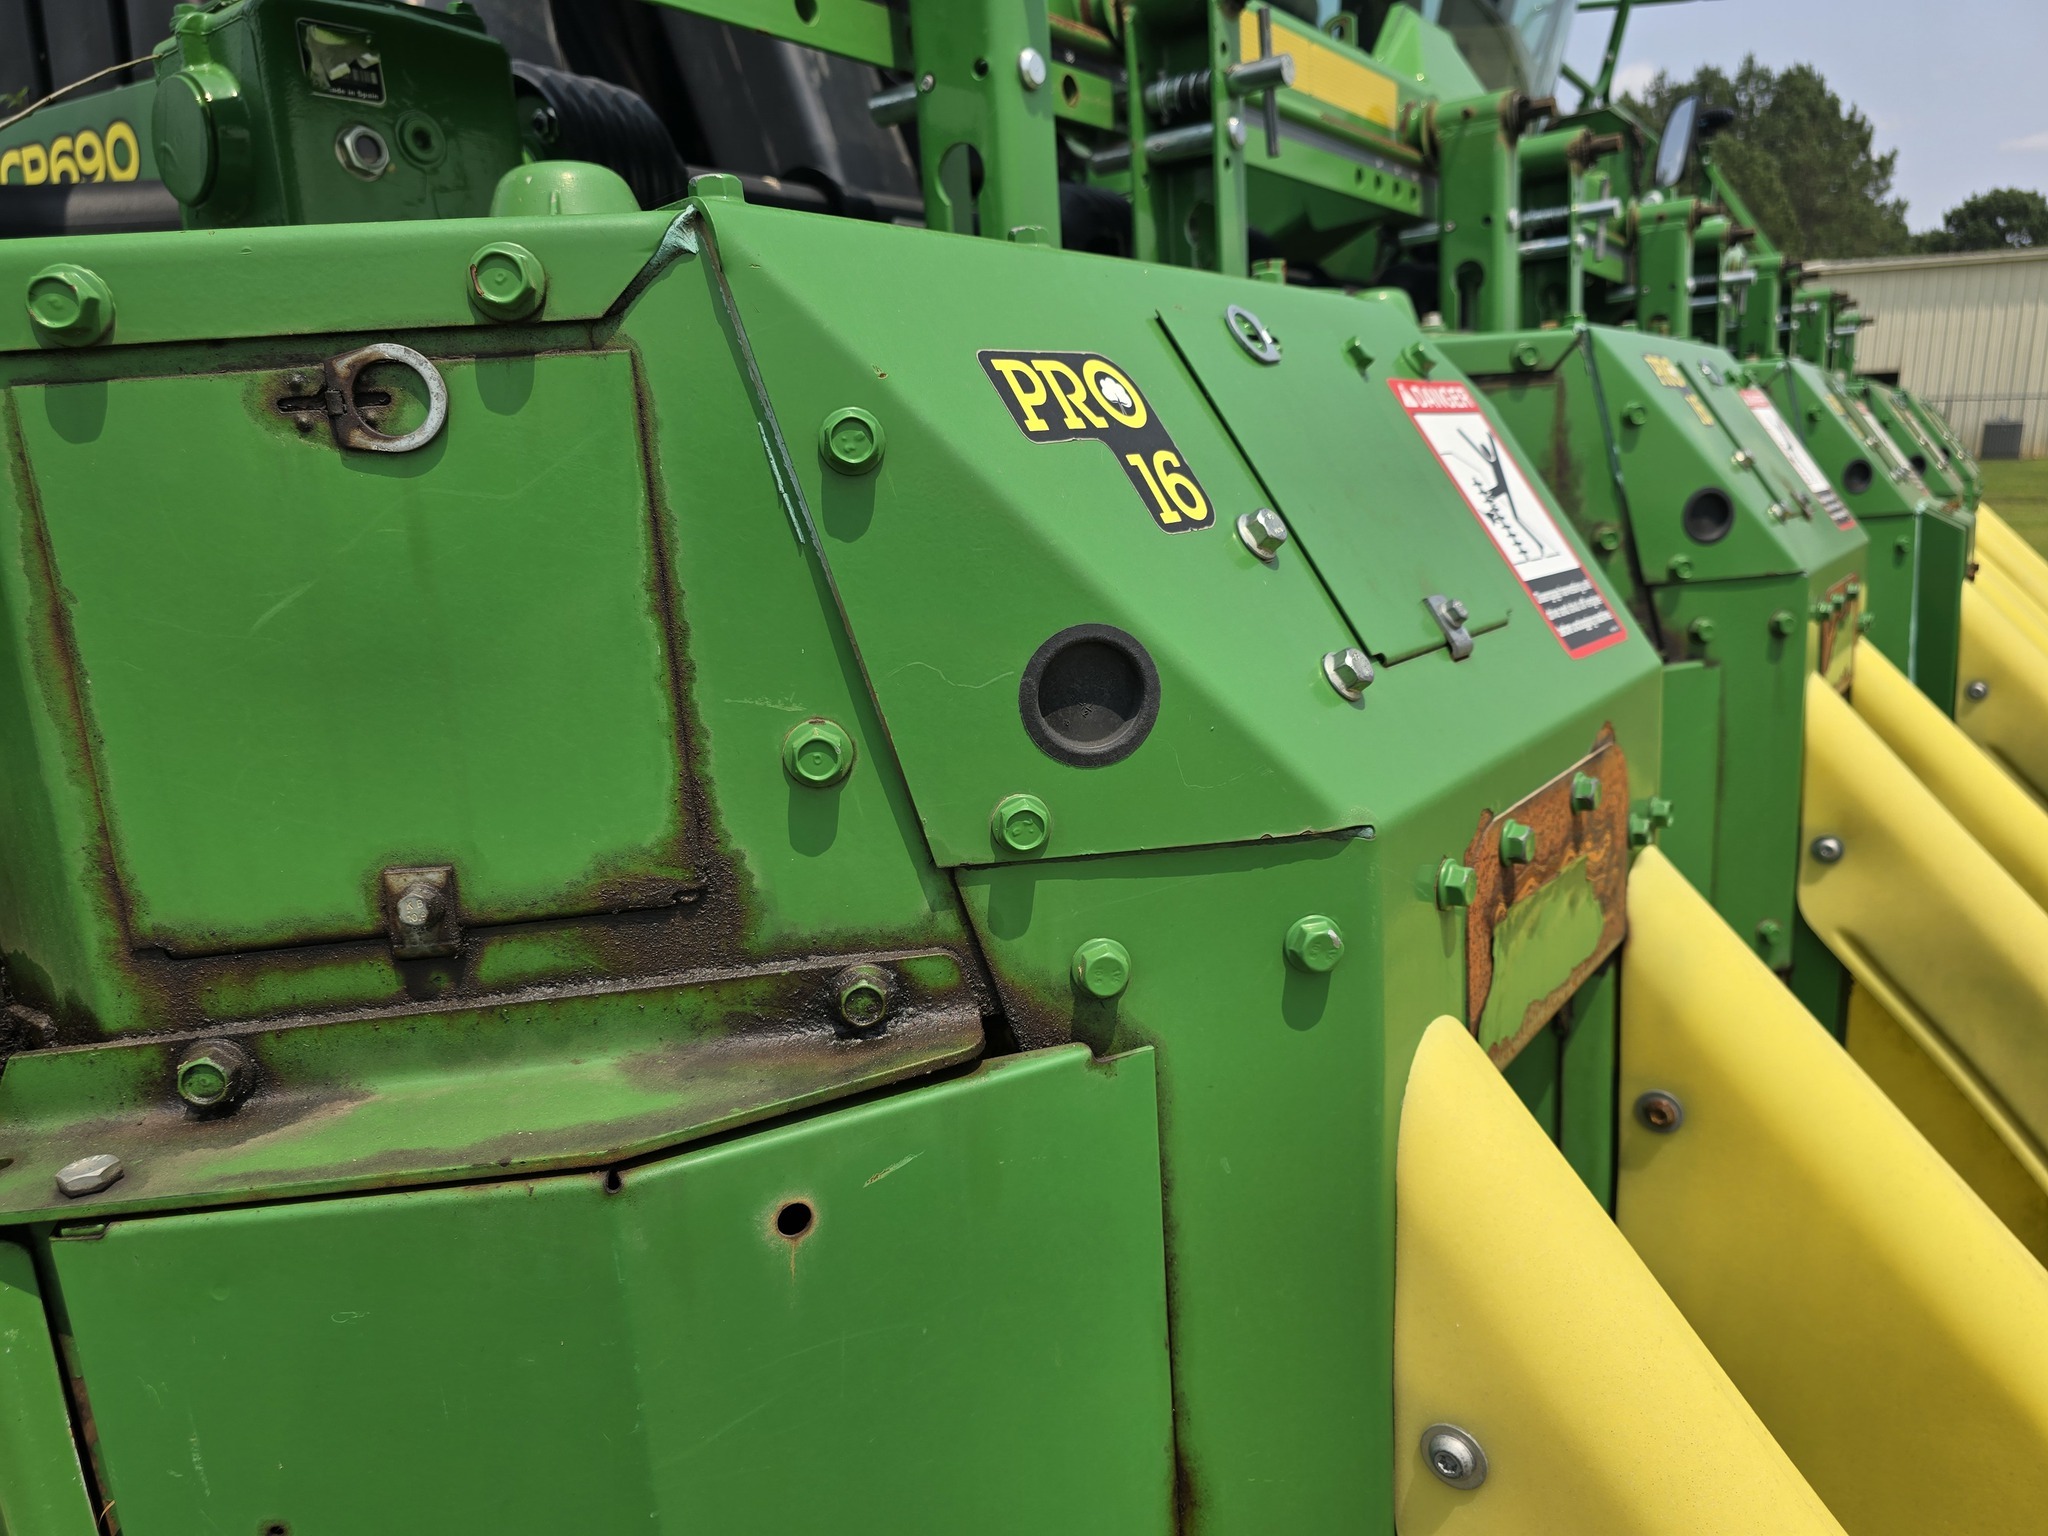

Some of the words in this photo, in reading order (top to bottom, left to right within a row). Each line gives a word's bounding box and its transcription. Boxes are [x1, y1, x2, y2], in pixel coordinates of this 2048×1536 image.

[991, 359, 1147, 431] PRO
[1410, 385, 1476, 408] DANGER
[1126, 450, 1207, 524] 16
